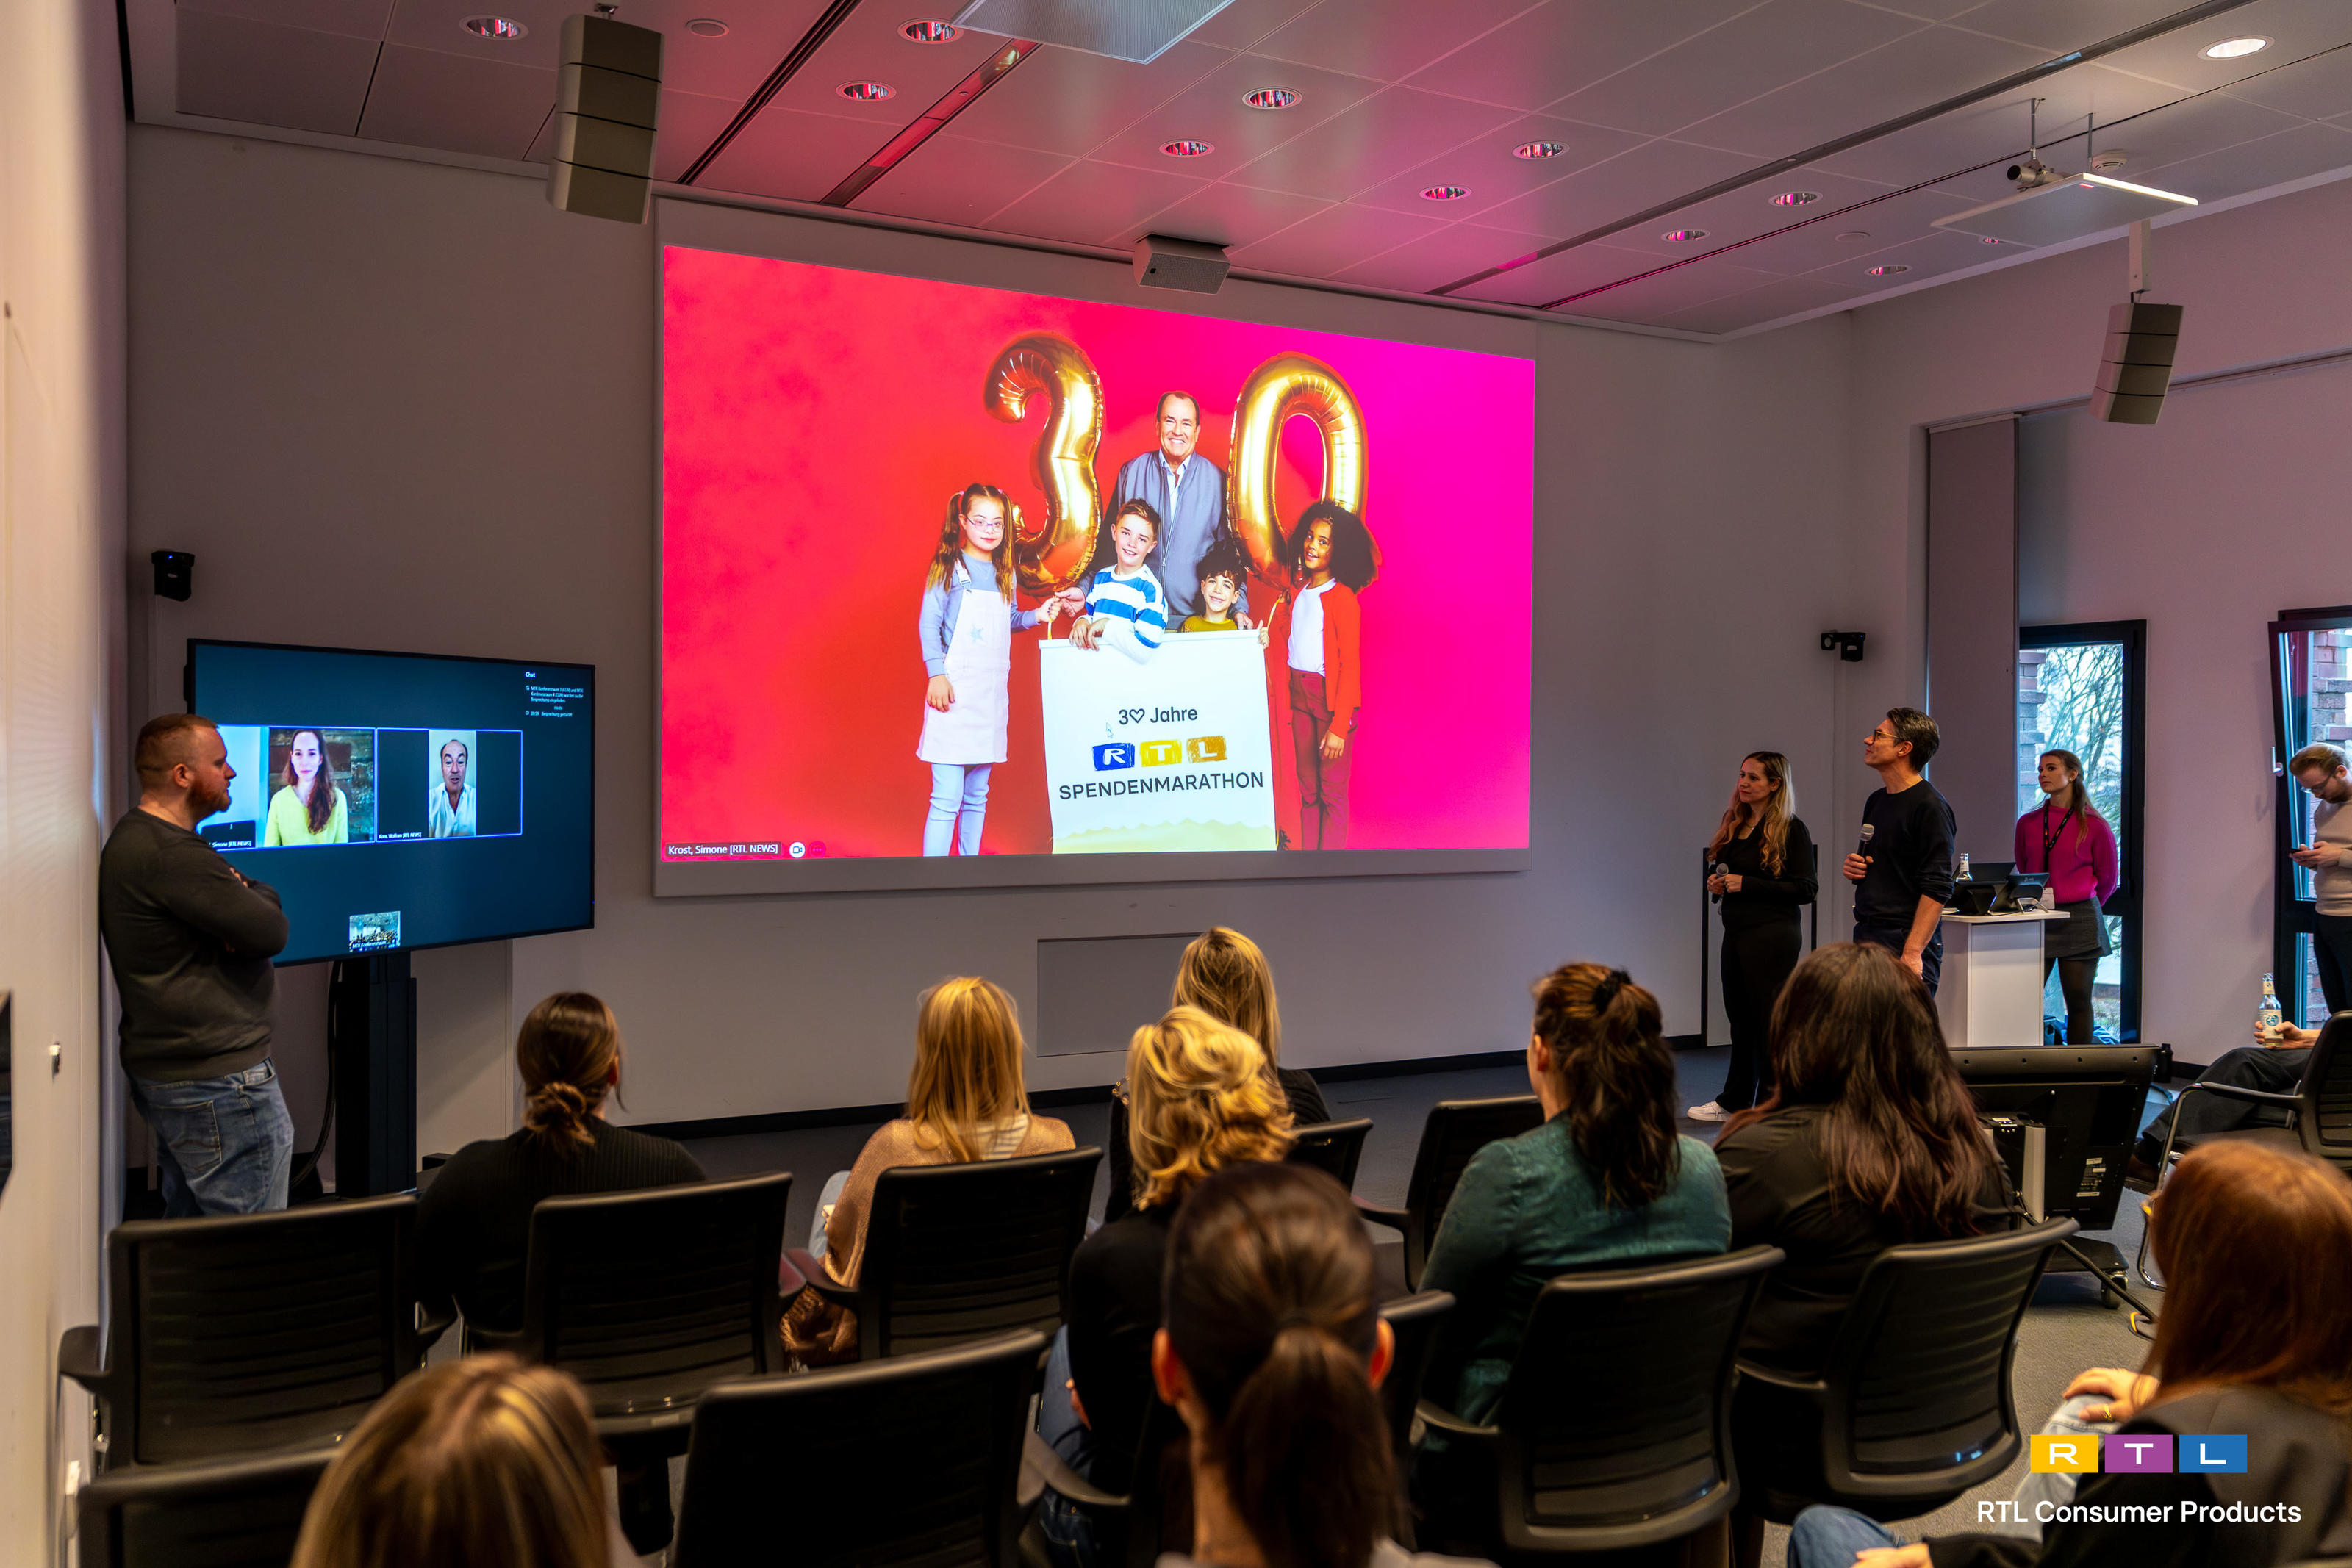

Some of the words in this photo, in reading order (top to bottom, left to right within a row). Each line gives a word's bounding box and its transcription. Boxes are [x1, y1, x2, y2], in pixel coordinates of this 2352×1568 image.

[1150, 706, 1199, 723] Jahre
[1059, 772, 1264, 800] SPENDENMARATHON
[668, 845, 693, 855] Krost,
[695, 844, 728, 854] Simone
[729, 844, 747, 855] [RTL
[749, 844, 778, 854] NEWS]
